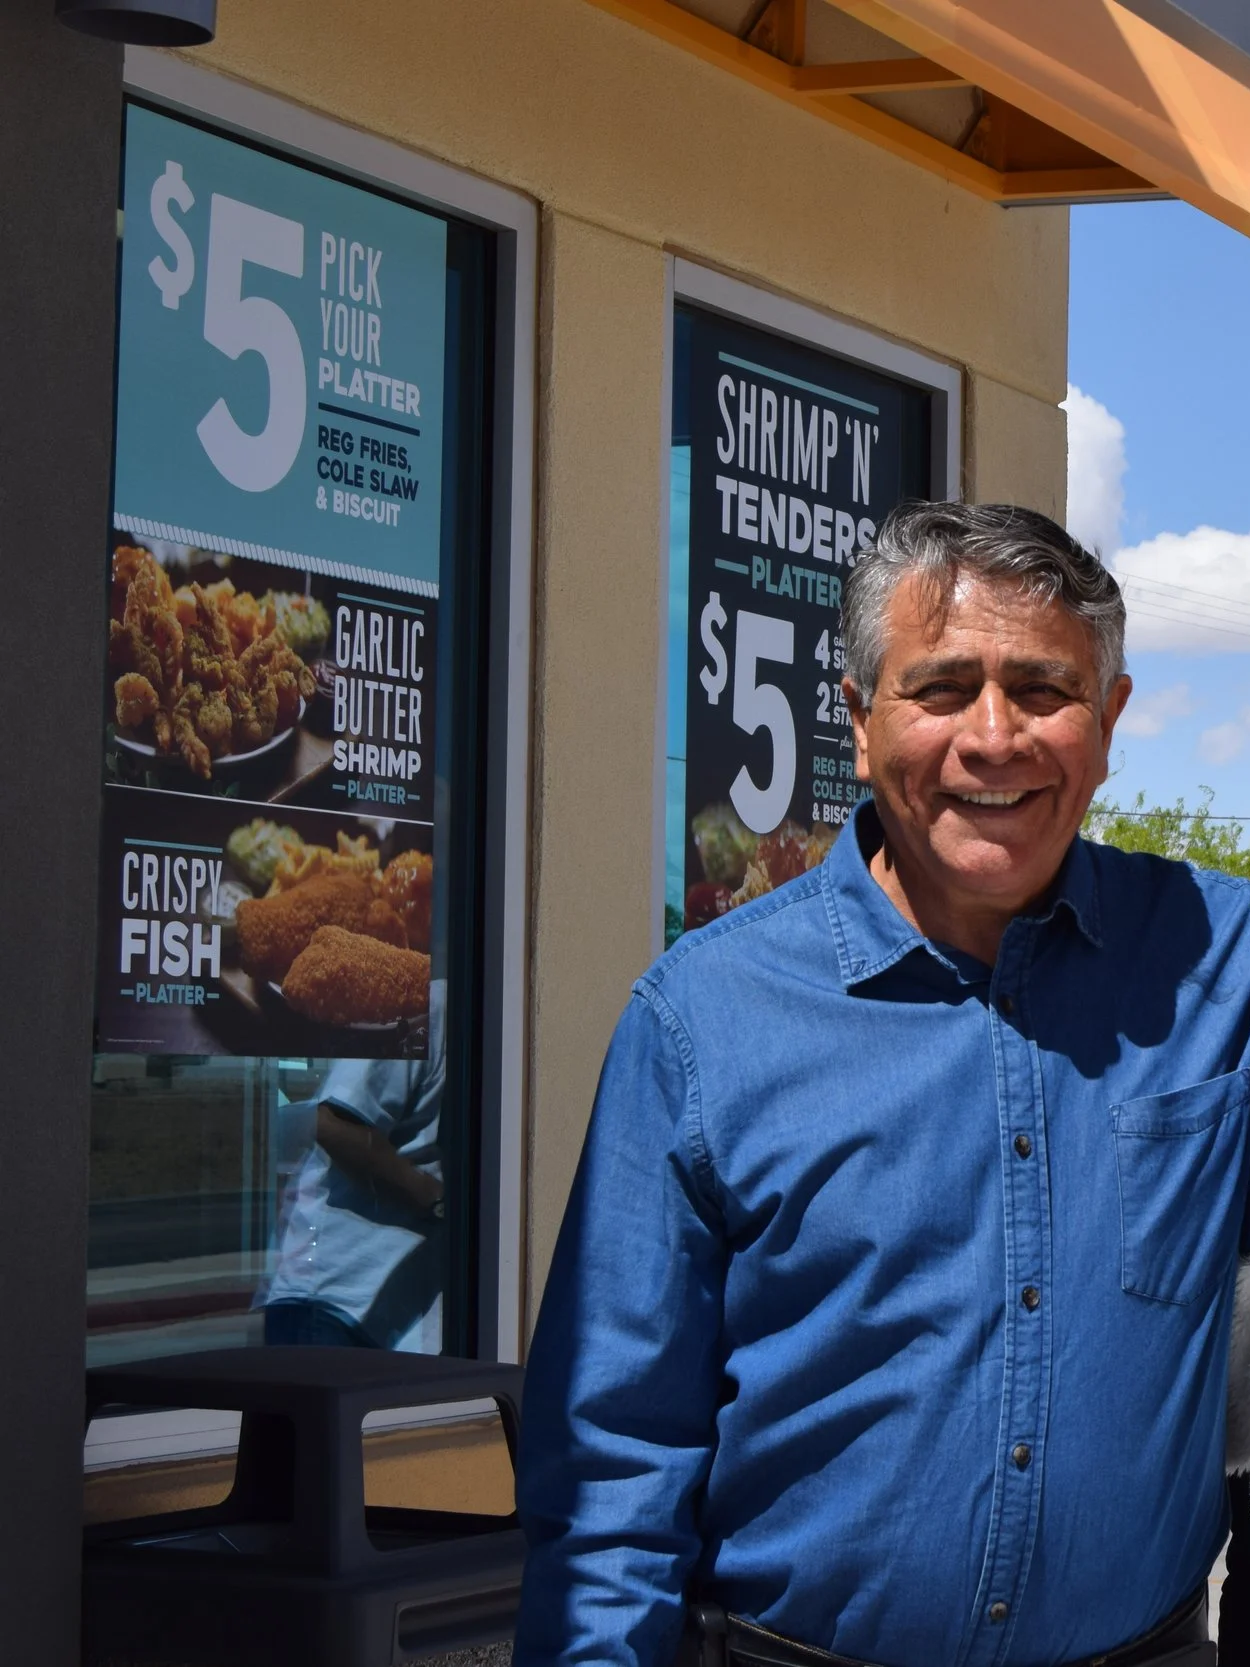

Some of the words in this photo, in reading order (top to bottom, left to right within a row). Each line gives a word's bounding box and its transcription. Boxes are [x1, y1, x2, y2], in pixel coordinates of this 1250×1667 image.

[320, 231, 383, 309] PICK
[148, 160, 307, 492] $5
[319, 298, 382, 366] YOUR
[318, 357, 421, 417] PLATTER
[318, 424, 354, 455] REG
[360, 435, 412, 473] FRIES,
[716, 374, 838, 494] SHRIMP
[317, 455, 365, 489] COLE
[369, 469, 420, 501] SLAW
[316, 485, 328, 511] &
[333, 489, 401, 528] BISCUIT
[751, 555, 842, 609] PLATTER
[335, 604, 425, 682] GARLIC
[815, 629, 830, 670] 4
[333, 674, 422, 745] BUTTER
[699, 590, 797, 834] $5
[816, 681, 830, 723] 2
[332, 739, 422, 781] SHRIMP
[813, 755, 836, 777] REG
[347, 780, 406, 806] PLATTER
[812, 779, 843, 801] COLE
[812, 802, 820, 821] &
[823, 803, 851, 825] BISC
[122, 851, 223, 916] CRISPY
[120, 918, 222, 979] FISH
[135, 983, 206, 1006] PLATTER
